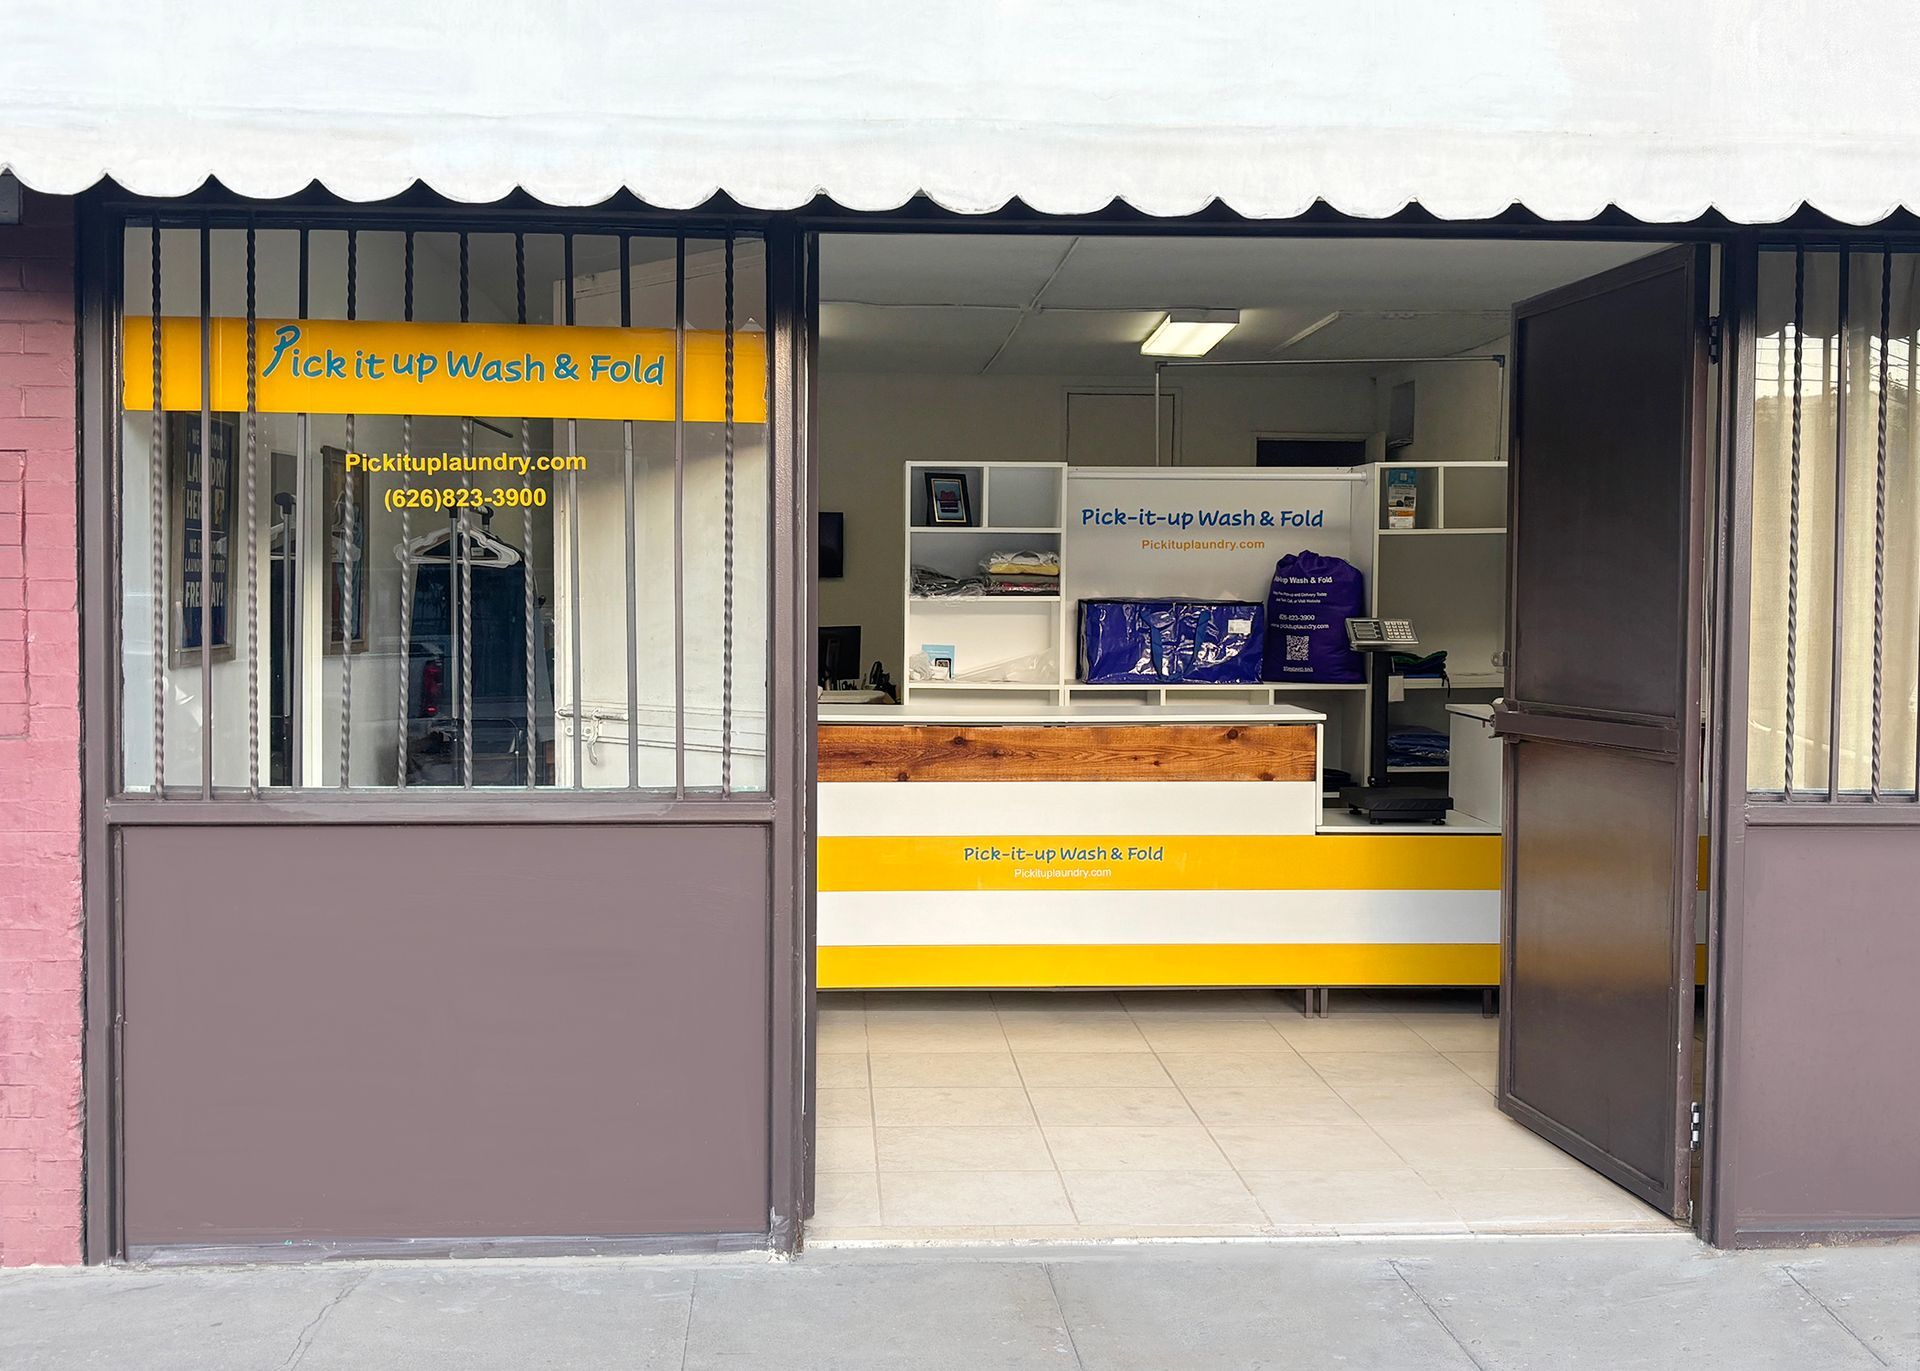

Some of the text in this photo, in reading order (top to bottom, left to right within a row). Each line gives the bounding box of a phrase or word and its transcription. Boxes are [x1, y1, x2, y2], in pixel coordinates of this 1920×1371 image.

[262, 325, 665, 386] Pick it up Wash & Fold
[345, 452, 587, 475] Pickituplaundry.com
[384, 488, 547, 512] (626)823-3900
[1081, 508, 1324, 530] Pick-it-up Wash & Fold
[1142, 539, 1265, 551] Pickituplaundry.com
[1289, 576, 1309, 584] Wash
[1310, 576, 1317, 584] &
[1318, 576, 1333, 584] Fold
[964, 846, 1164, 864] Pick-it-up Wash & Fold
[1014, 868, 1112, 879] Pickituplaundry.com
